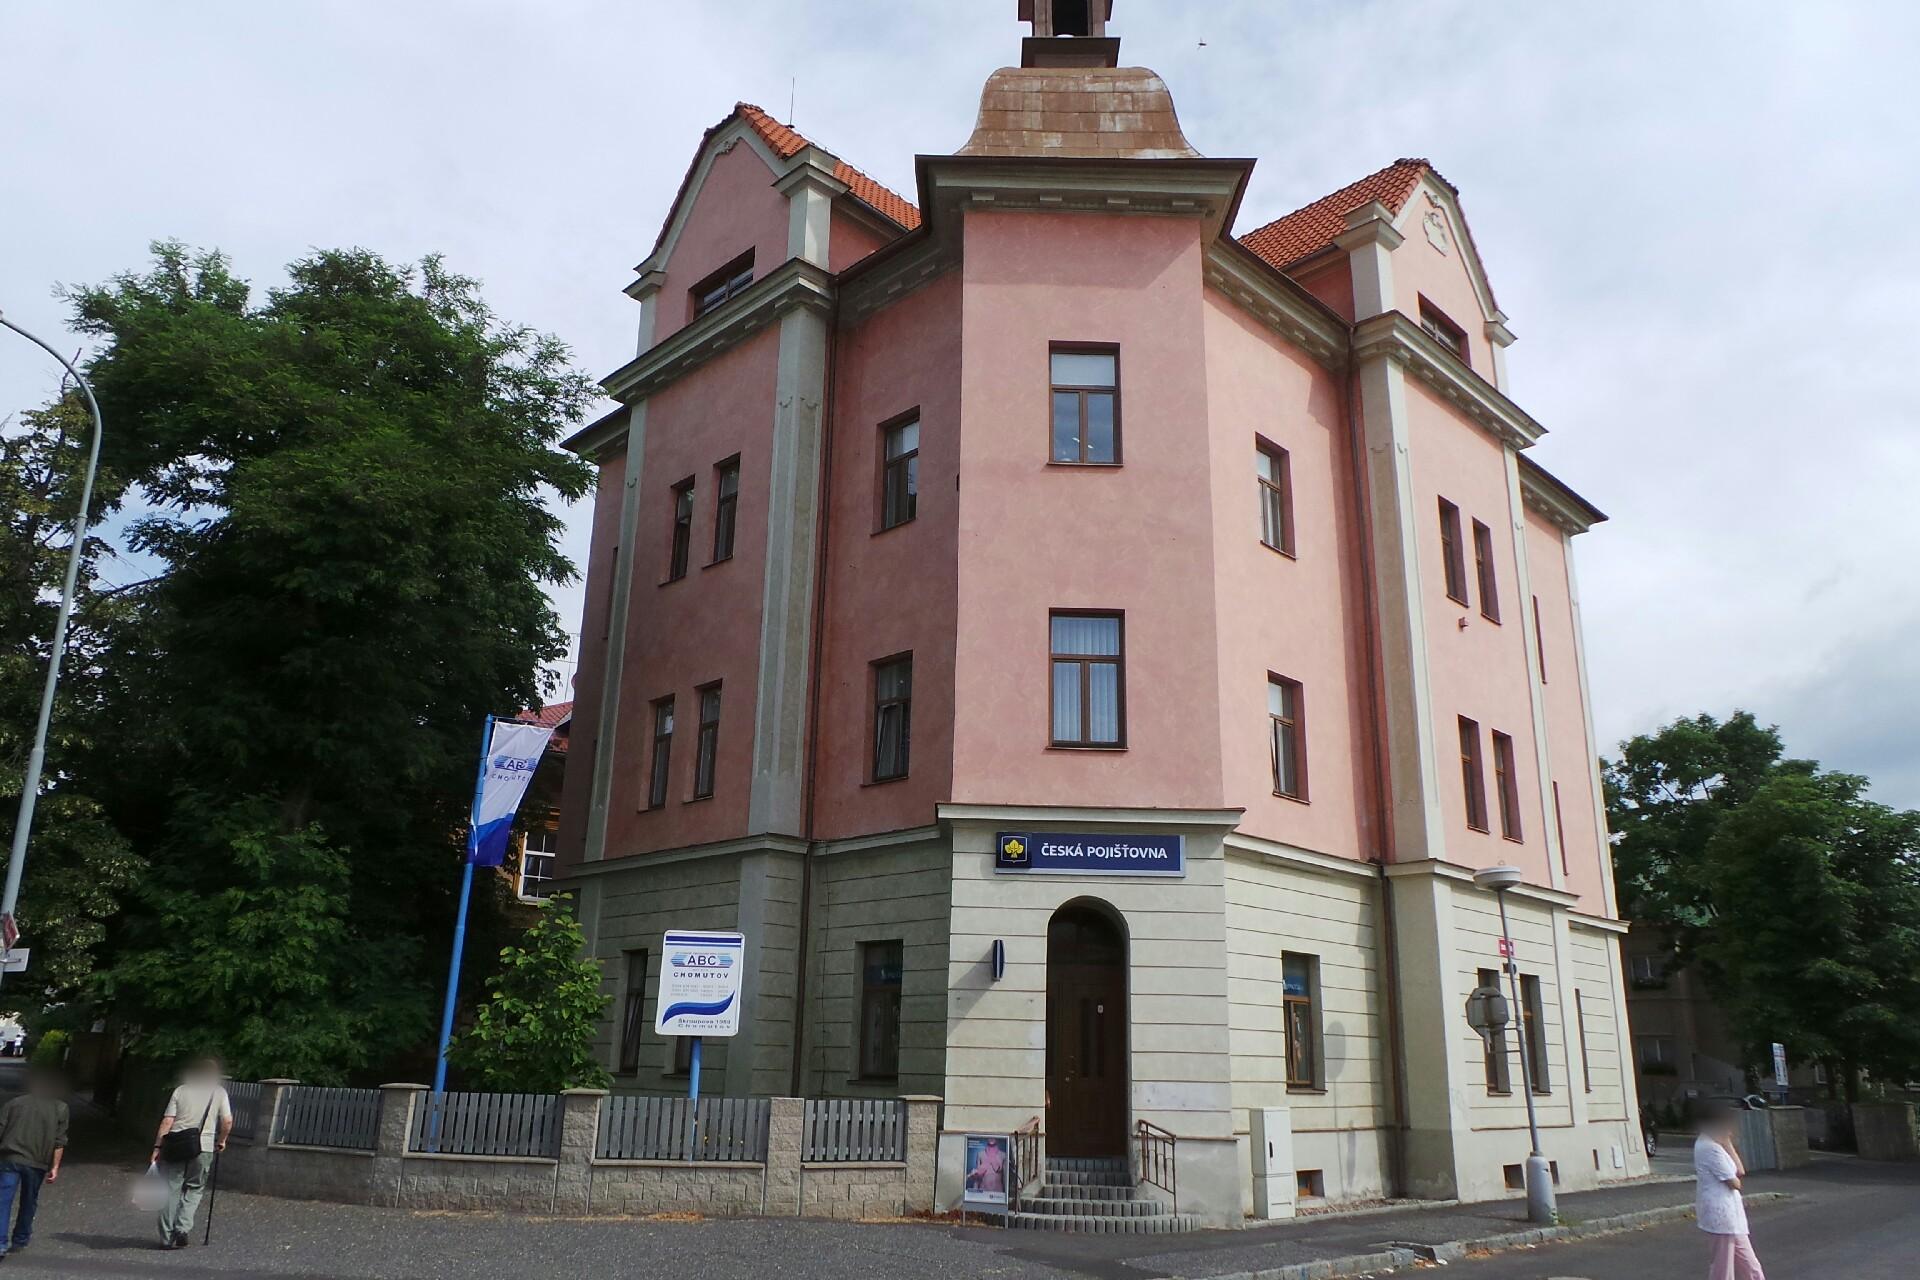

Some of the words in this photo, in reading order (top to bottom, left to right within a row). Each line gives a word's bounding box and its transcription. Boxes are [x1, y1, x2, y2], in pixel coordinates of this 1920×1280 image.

[1041, 843, 1083, 857] ČESKÁ
[1088, 843, 1167, 859] POJIŠŤOVNA
[688, 956, 716, 965] ABC
